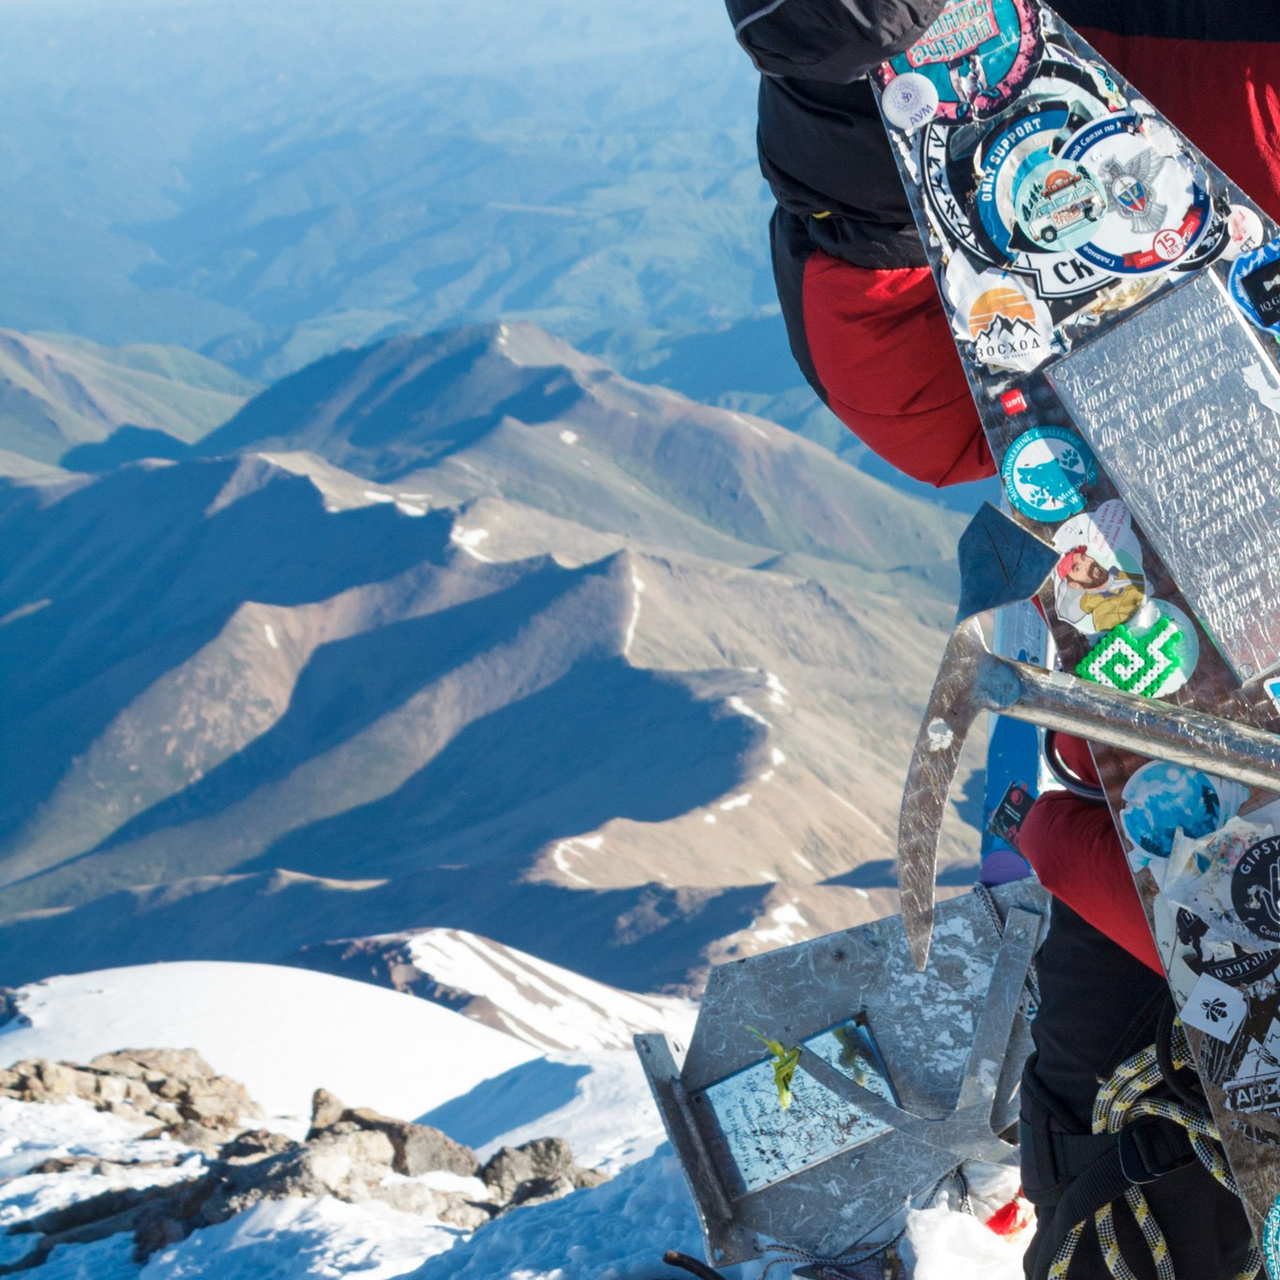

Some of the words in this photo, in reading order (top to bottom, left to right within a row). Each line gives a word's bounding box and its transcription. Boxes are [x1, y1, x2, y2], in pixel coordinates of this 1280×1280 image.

[909, 104, 934, 127] АУМ
[981, 166, 996, 202] ONLY
[989, 117, 1042, 165] SUPPORT
[1156, 233, 1177, 252] 15
[1165, 244, 1181, 259] ЛЕТ
[1259, 300, 1273, 313] IQ
[1005, 435, 1034, 501] MOUNTAINEERING
[1035, 428, 1082, 448] CHALLENGE
[1240, 839, 1280, 875] GIPSY
